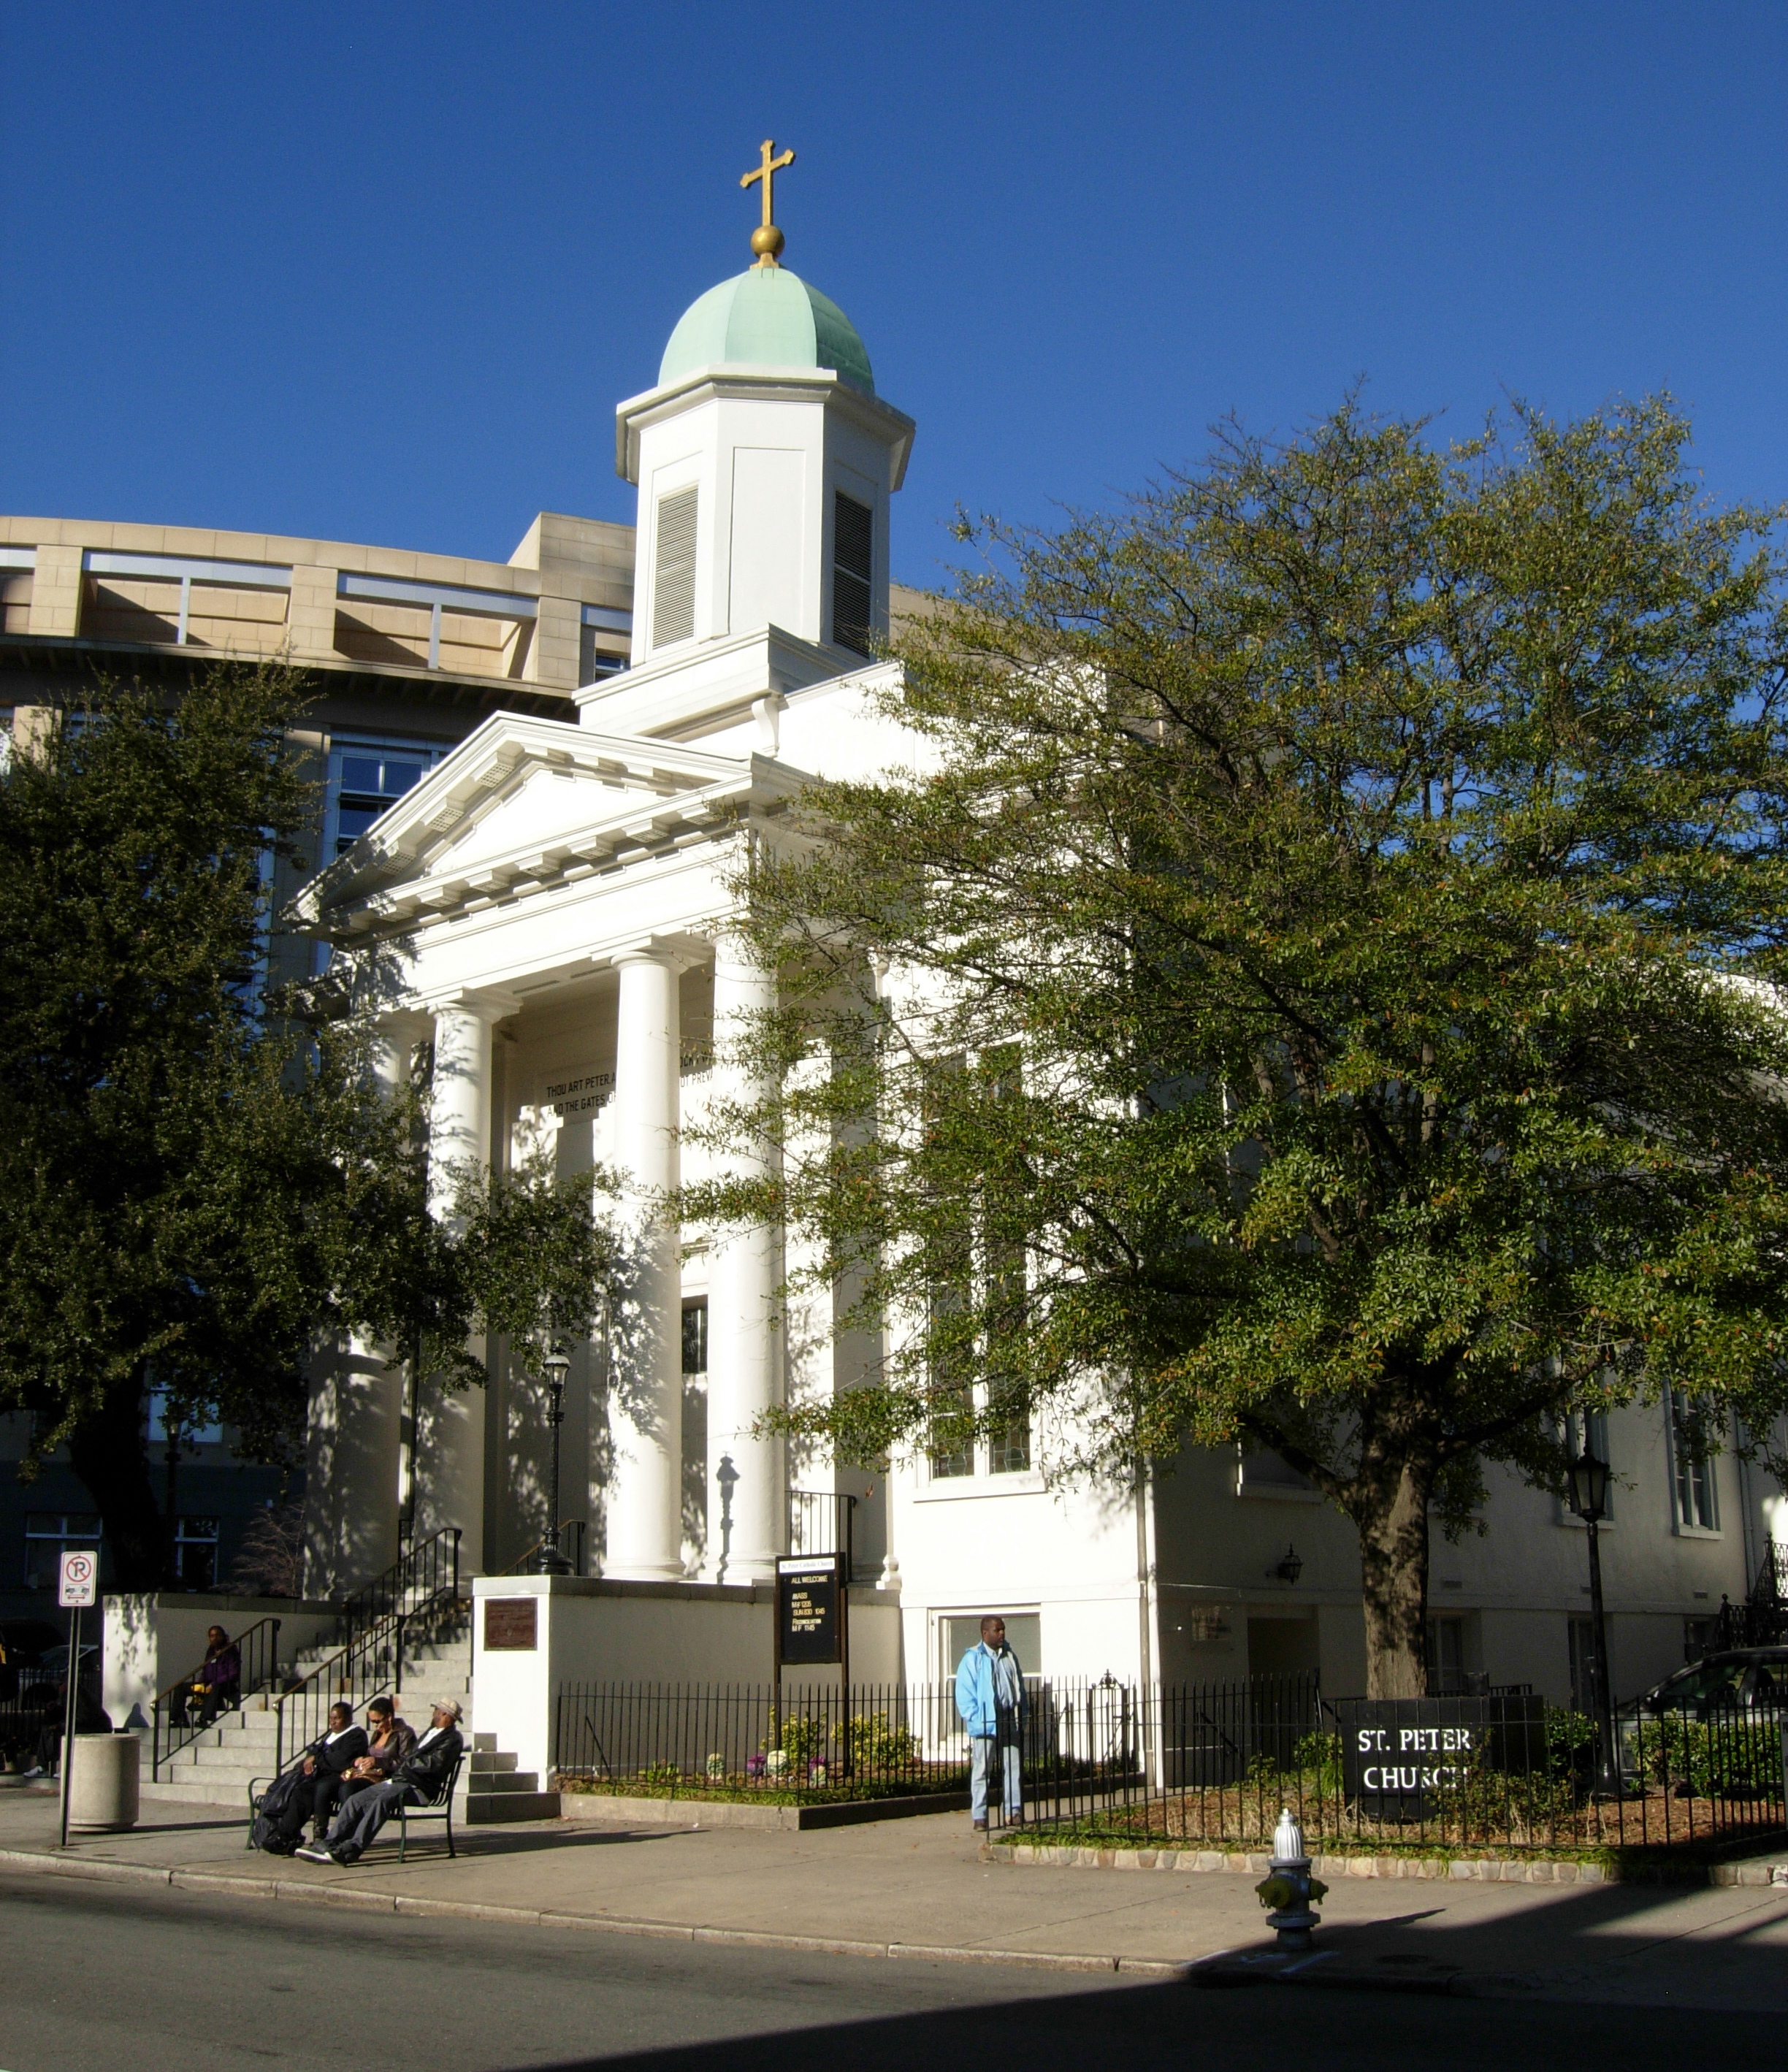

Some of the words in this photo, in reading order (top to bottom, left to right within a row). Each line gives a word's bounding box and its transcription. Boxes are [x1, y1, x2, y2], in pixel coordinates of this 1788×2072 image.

[547, 1084, 567, 1098] THOU
[568, 1079, 584, 1093] ART
[547, 1103, 564, 1117] AND
[565, 1099, 579, 1112] THE
[581, 1094, 605, 1109] GATES
[790, 1576, 801, 1584] ALL
[802, 1575, 828, 1583] WELCOME
[1359, 1729, 1391, 1751] ST.
[1399, 1728, 1472, 1751] PETER
